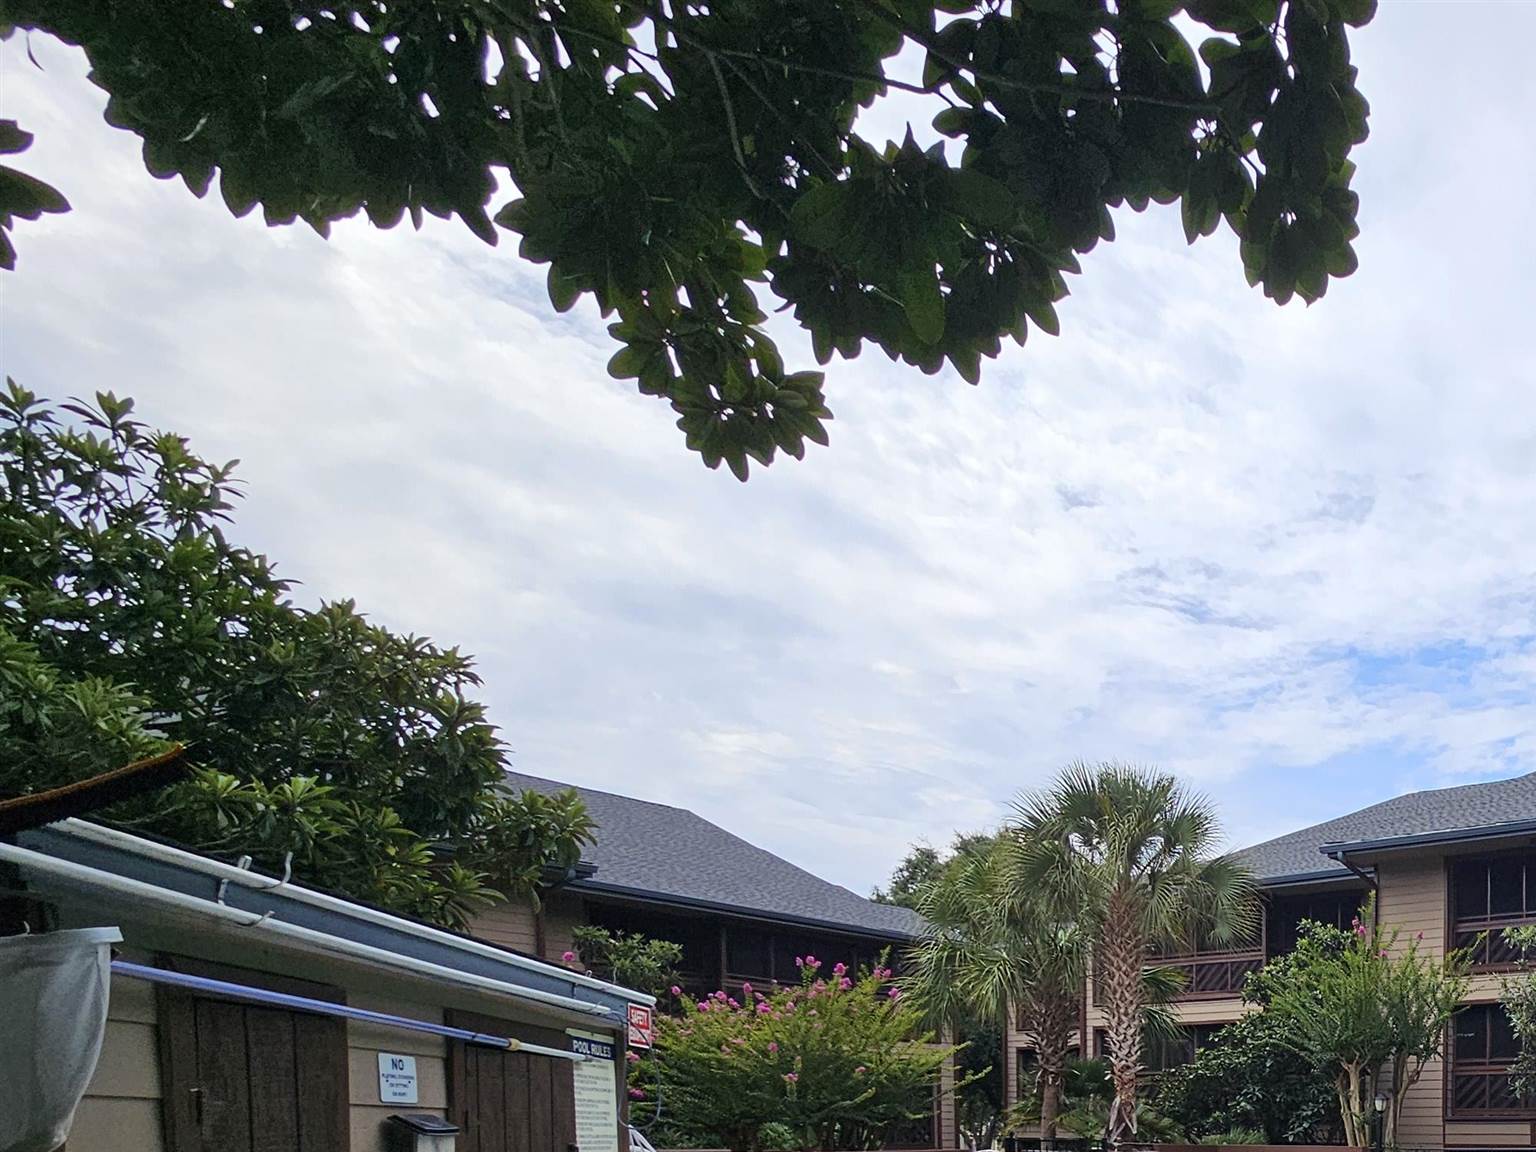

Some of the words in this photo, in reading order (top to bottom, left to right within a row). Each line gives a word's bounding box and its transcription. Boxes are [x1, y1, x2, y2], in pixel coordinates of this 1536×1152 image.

[573, 1040, 590, 1054] POOL
[591, 1044, 612, 1058] RULES
[391, 1058, 404, 1071] NO
